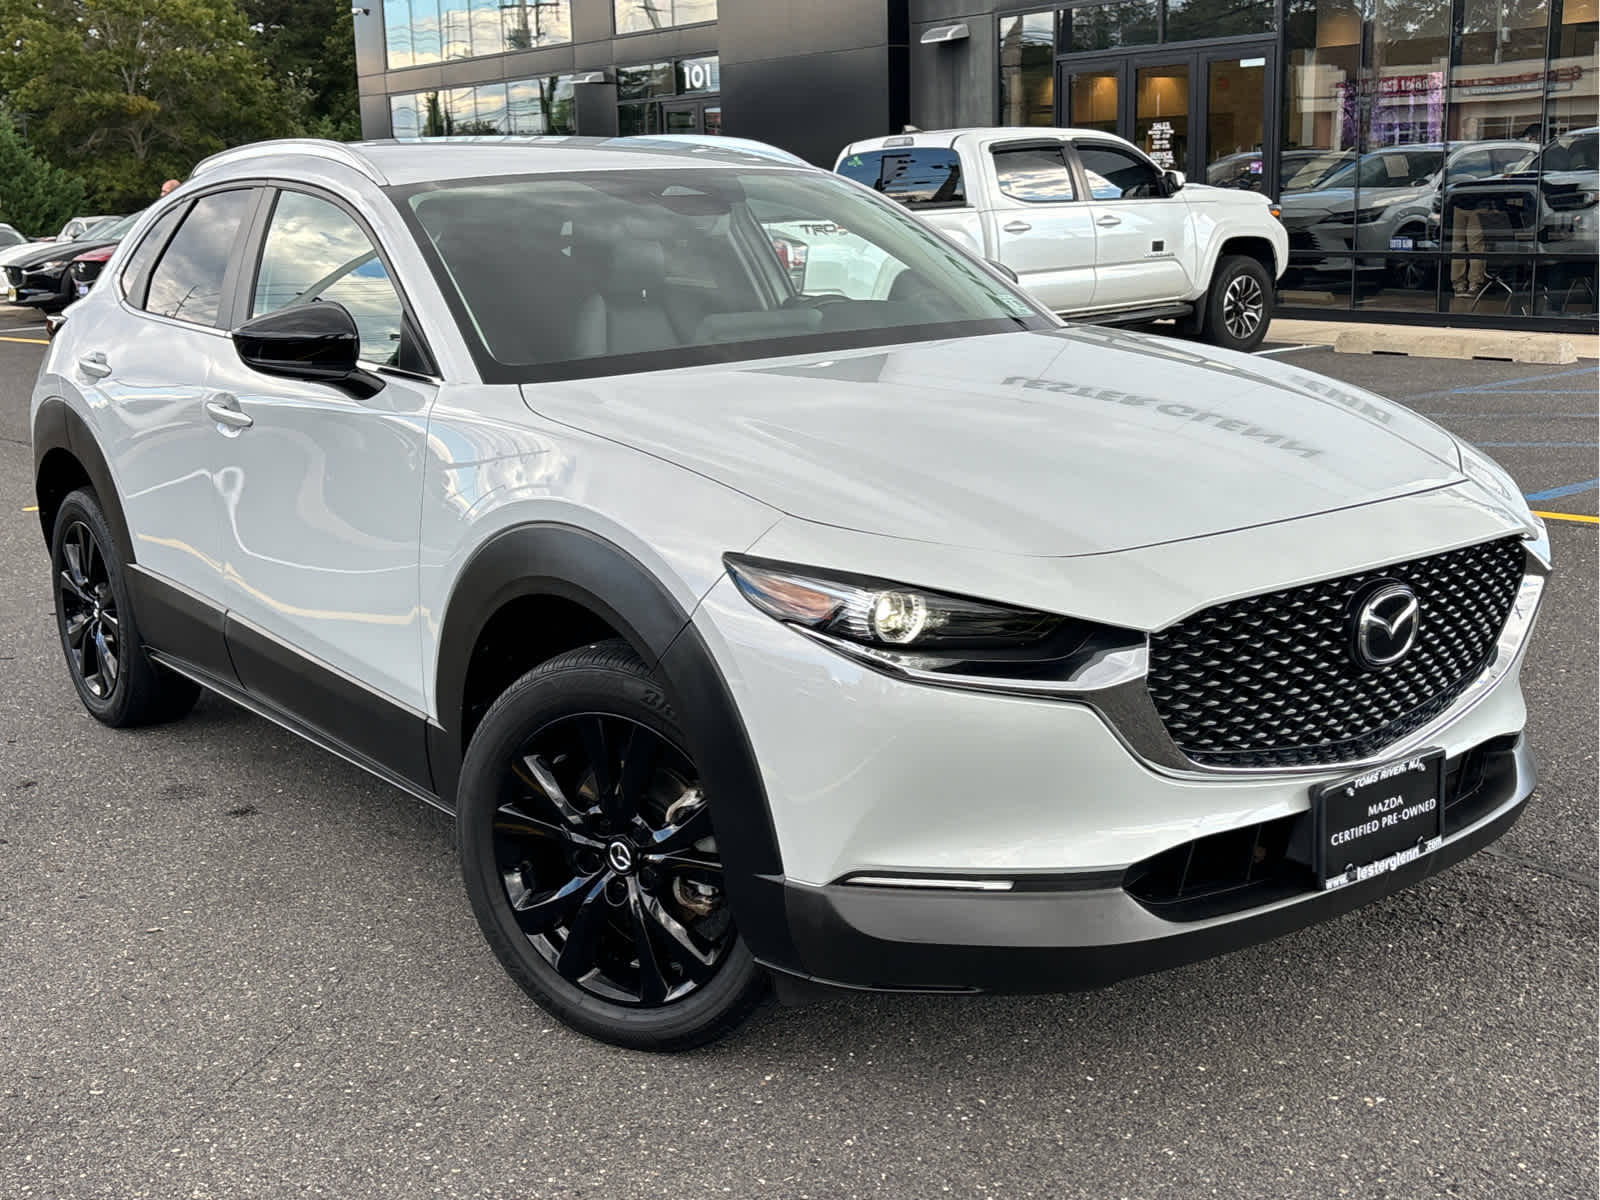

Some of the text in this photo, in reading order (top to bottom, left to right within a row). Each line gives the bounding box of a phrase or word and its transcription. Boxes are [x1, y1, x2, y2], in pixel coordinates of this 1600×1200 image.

[683, 64, 712, 89] 101
[1354, 772, 1379, 789] TOMS
[1367, 795, 1404, 817] MAZDA
[1331, 798, 1437, 847] CERTIFIED PRE-OWNED
[1356, 846, 1420, 881] lesterglenn
